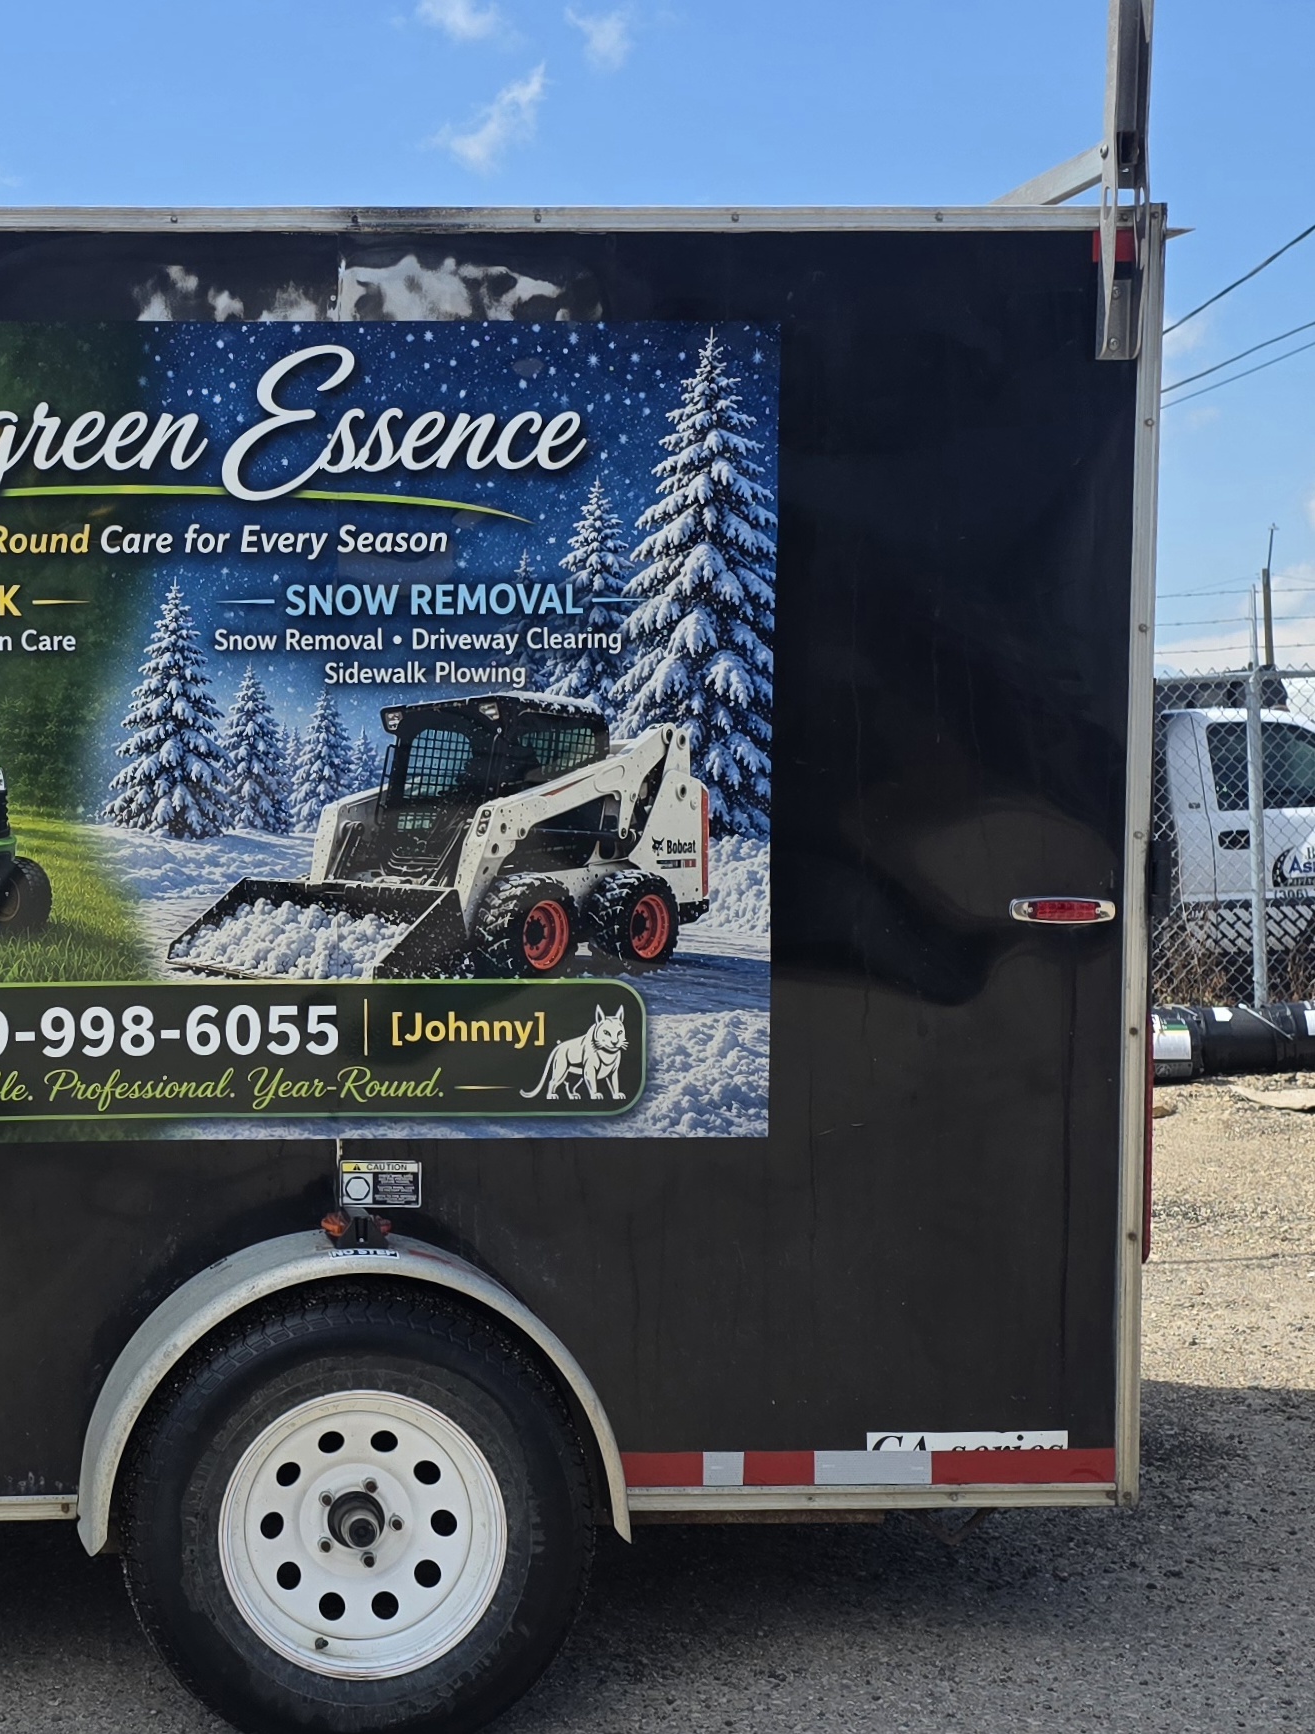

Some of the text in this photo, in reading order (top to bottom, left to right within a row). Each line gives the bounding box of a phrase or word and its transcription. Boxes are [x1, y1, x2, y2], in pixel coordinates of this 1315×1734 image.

[222, 344, 587, 502] Essence
[100, 525, 173, 554] Care
[184, 525, 230, 553] for
[240, 524, 327, 560] Every
[337, 524, 448, 553] Season
[285, 583, 584, 616] SNOW REMOVAL
[21, 630, 76, 652] Care
[214, 626, 623, 655] Snow Removal Driveway Clearing
[324, 662, 527, 688] Sidewalk Plowing
[666, 839, 697, 855] Bobcat
[391, 1011, 546, 1048] [Johnny]
[44, 1067, 235, 1111] Professional.
[247, 1066, 445, 1110] Year-Round.
[366, 1163, 407, 1171] CAUTION
